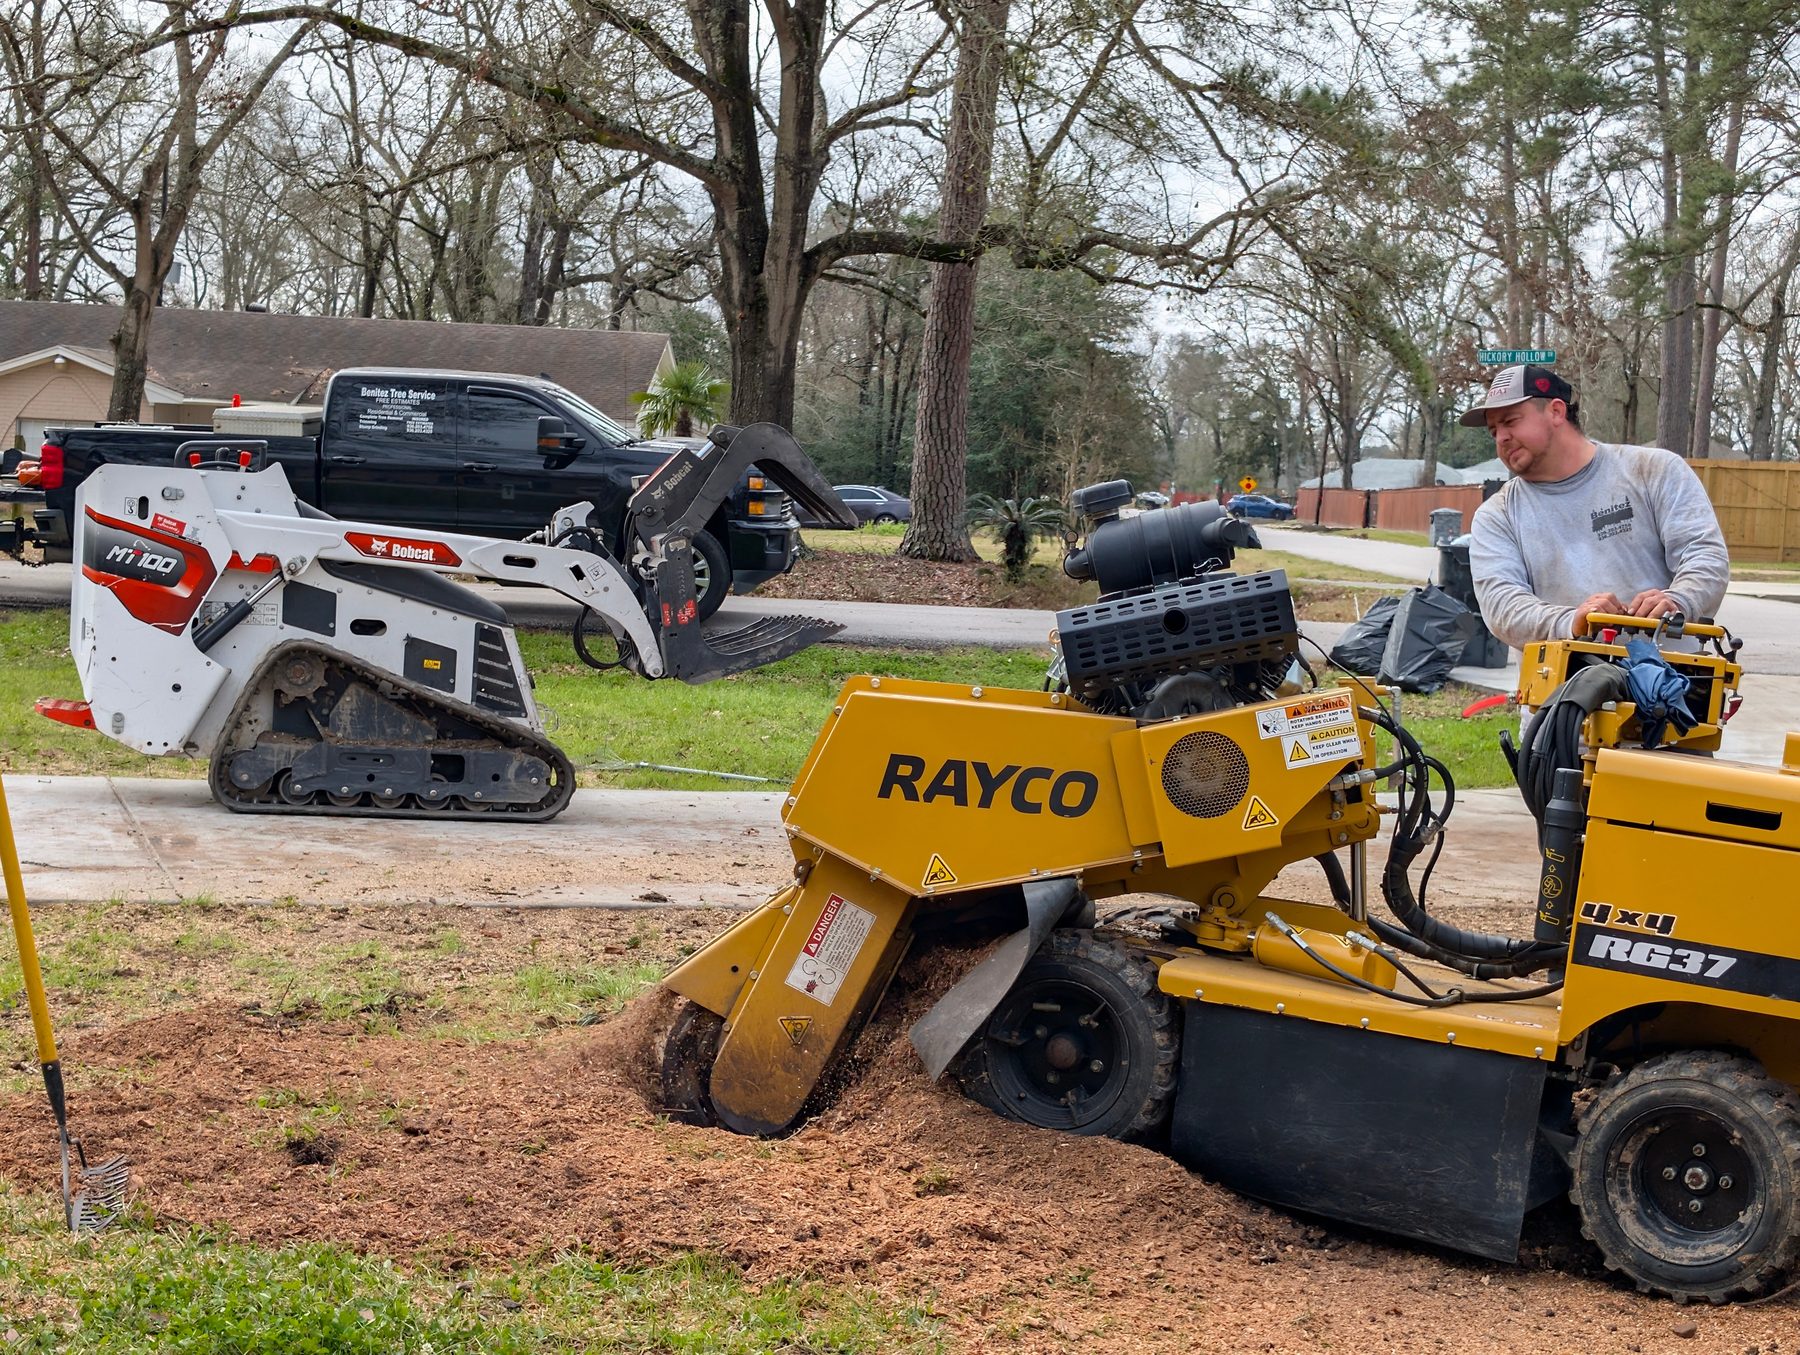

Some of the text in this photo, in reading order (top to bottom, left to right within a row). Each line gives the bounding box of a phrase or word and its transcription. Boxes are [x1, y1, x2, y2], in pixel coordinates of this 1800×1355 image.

[1480, 352, 1512, 362] HICKORY
[1516, 352, 1546, 361] HOLLOW
[361, 387, 436, 400] Benitez Tree Service
[664, 462, 692, 490] Bobcat
[1591, 500, 1631, 519] Benitez
[106, 546, 178, 574] MT100
[392, 544, 434, 560] Bobcat
[1319, 726, 1354, 739] CAUTION
[1320, 748, 1348, 758] OPERATION
[878, 754, 1098, 818] RAYCO
[813, 899, 840, 942] DANGER
[1581, 902, 1676, 936] 4x4
[1588, 934, 1738, 978] RG37
